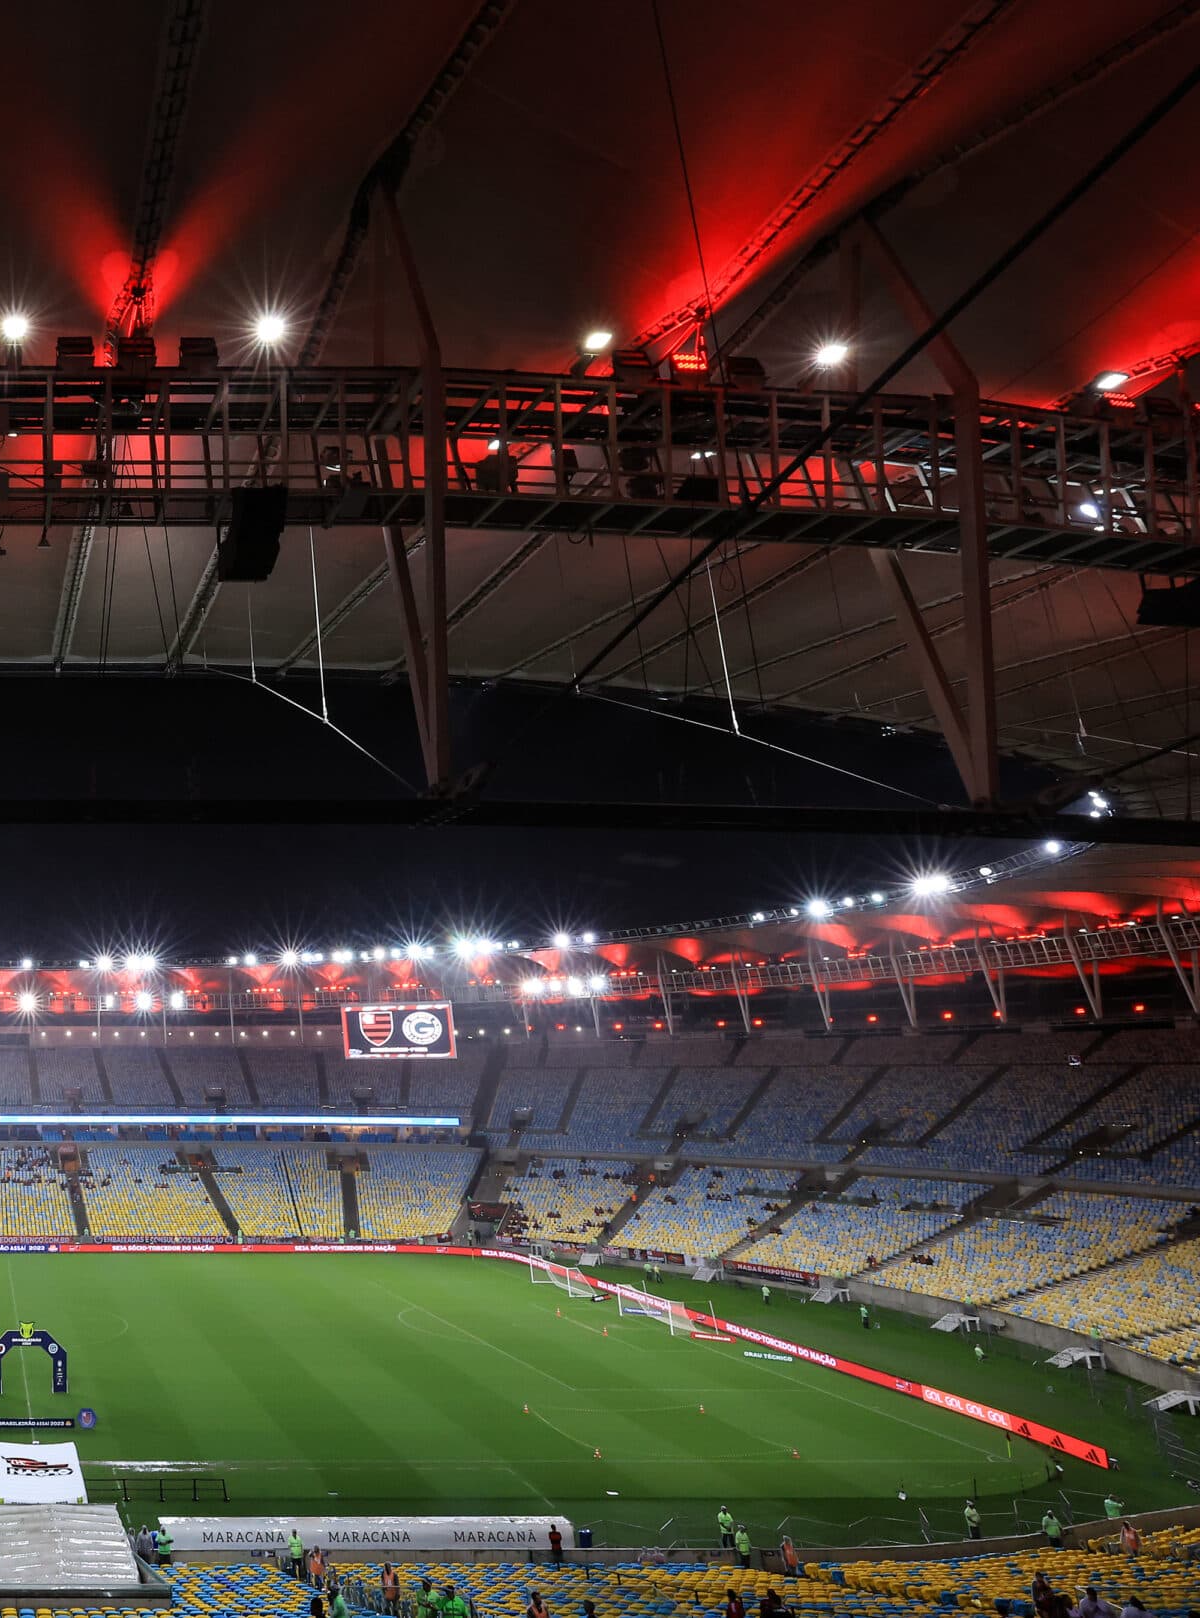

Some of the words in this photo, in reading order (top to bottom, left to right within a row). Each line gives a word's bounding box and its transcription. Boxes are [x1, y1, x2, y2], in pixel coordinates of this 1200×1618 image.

[726, 1323, 740, 1334] SEJA
[810, 1352, 836, 1366] NAÇÃO
[925, 1389, 943, 1403] GOL
[945, 1396, 963, 1410] GOL
[966, 1403, 985, 1418] GOL
[987, 1410, 1008, 1426] GOL
[453, 1530, 537, 1542] MARACANÃ
